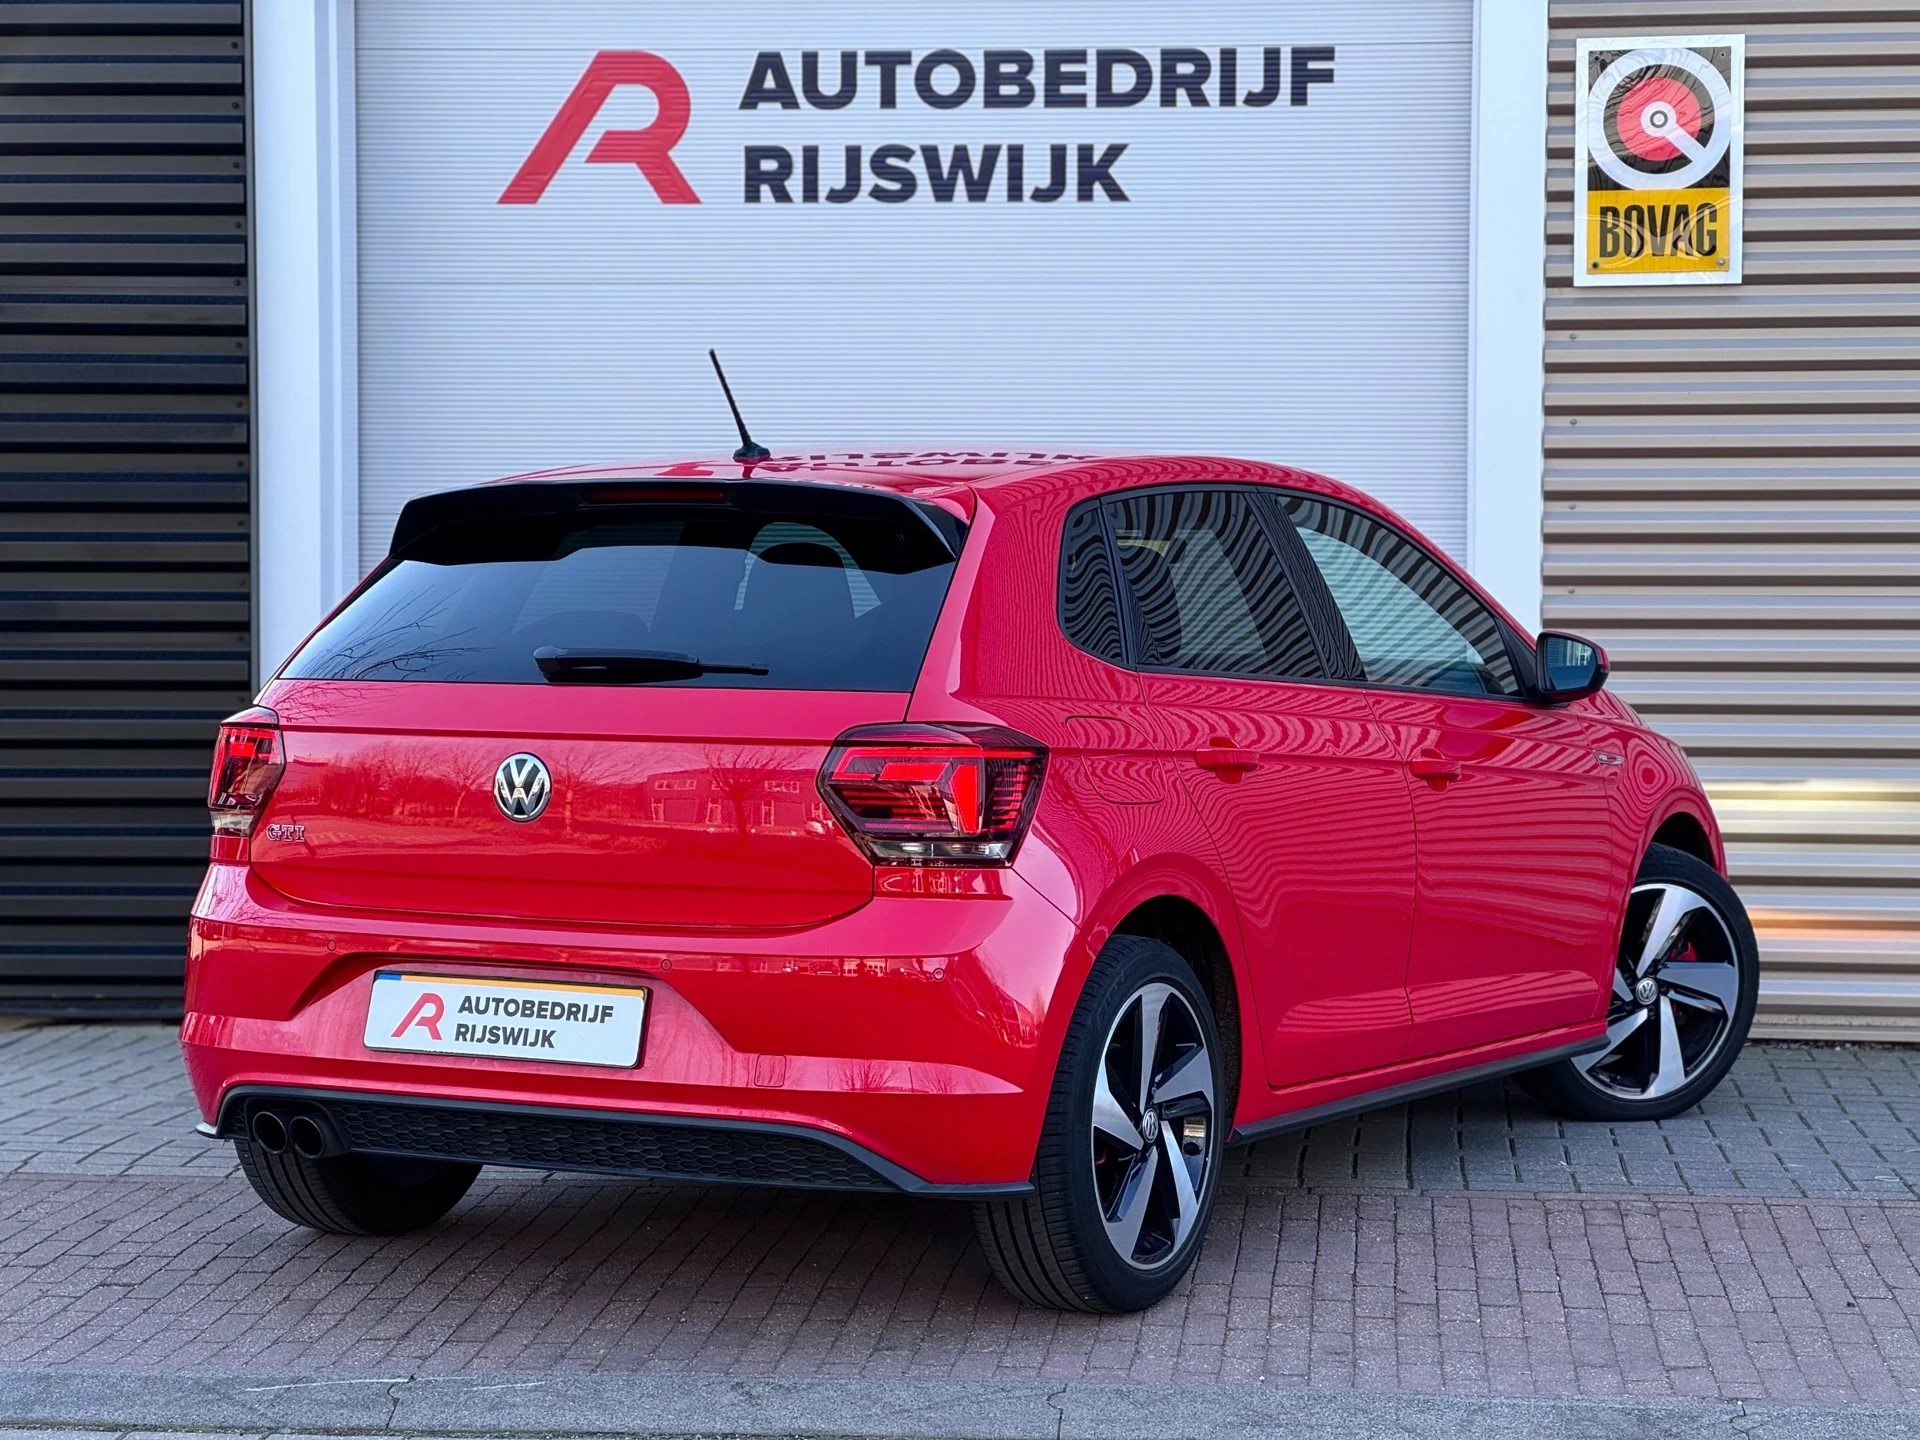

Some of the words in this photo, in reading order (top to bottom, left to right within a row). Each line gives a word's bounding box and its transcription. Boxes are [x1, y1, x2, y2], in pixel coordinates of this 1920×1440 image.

[739, 46, 1335, 110] AUTOBEDRIJF
[744, 144, 1131, 203] RIJSWIJK
[1599, 202, 1718, 258] BOVAG
[266, 823, 305, 842] GTI
[458, 995, 614, 1024] AUTOBEDRIJF
[454, 1023, 557, 1049] RIJSWIJK
